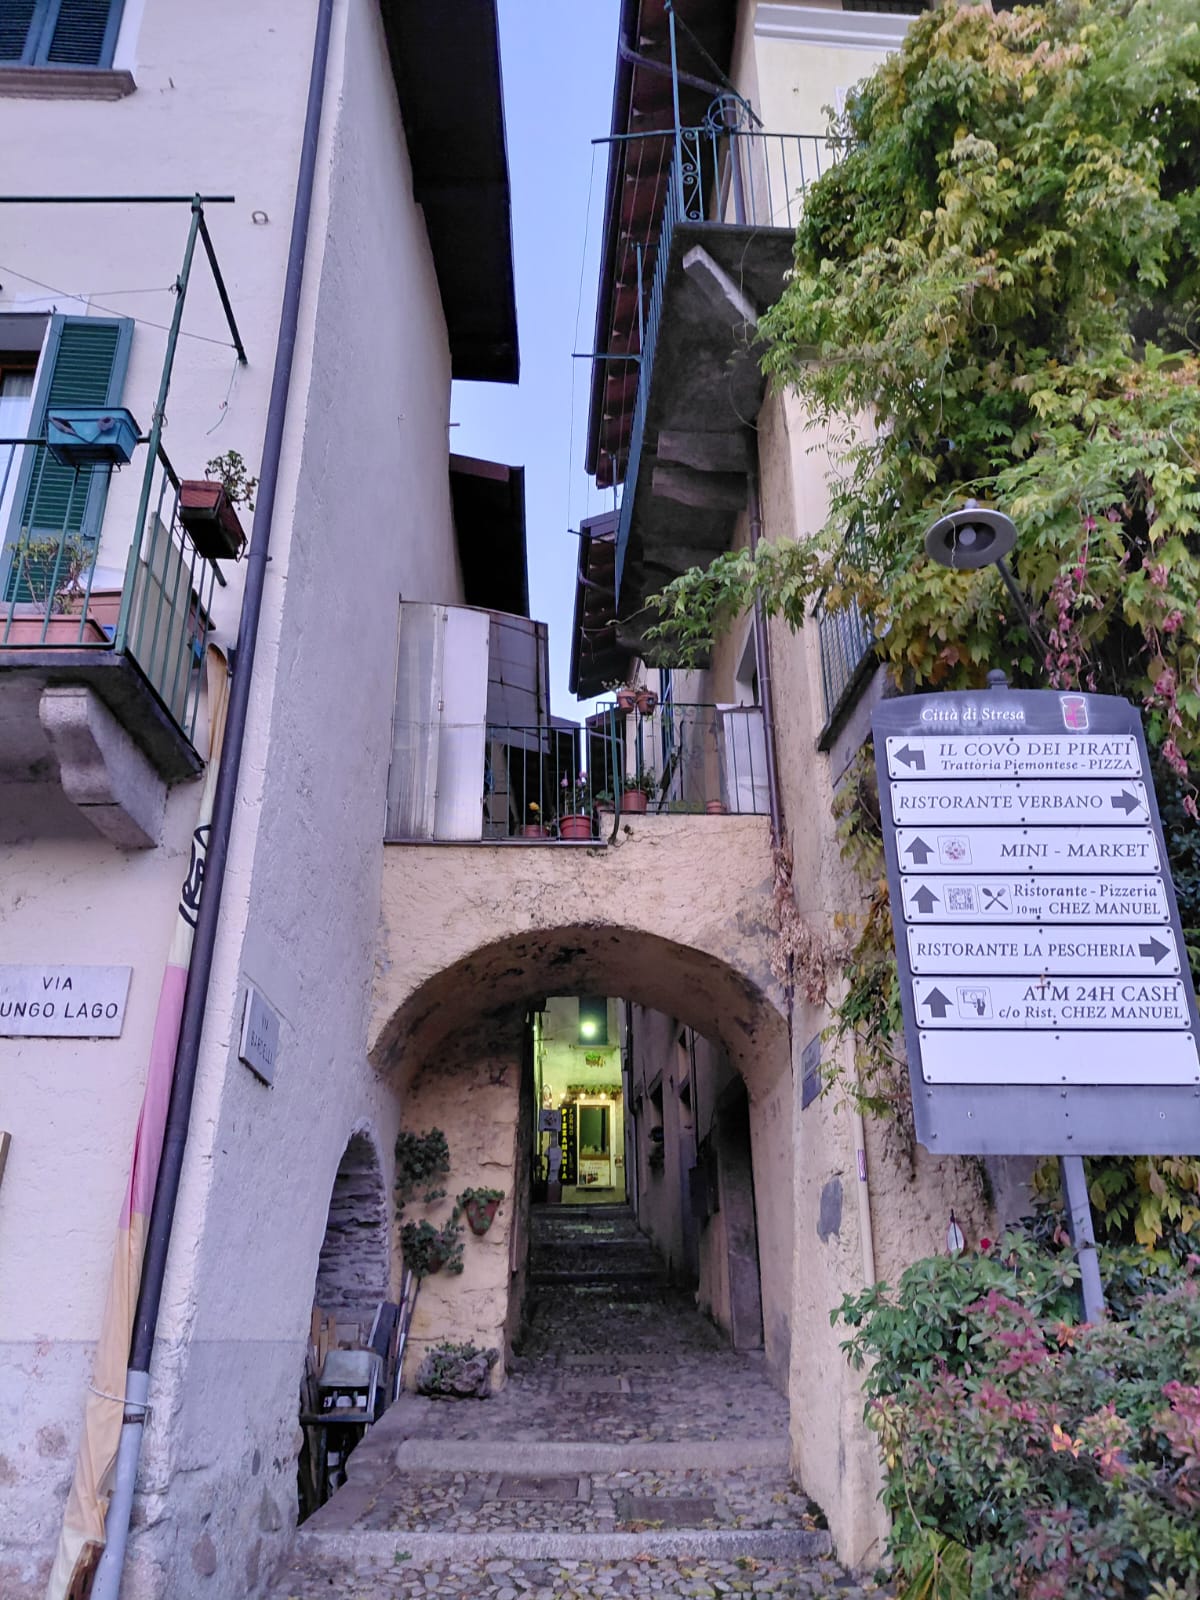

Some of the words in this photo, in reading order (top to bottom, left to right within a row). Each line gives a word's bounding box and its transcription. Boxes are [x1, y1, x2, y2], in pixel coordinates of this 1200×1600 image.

[922, 708, 957, 720] Città
[963, 707, 976, 720] di
[982, 708, 1024, 720] Stresa
[940, 744, 957, 756] IL
[965, 743, 1020, 755] COVO
[1028, 743, 1059, 755] DEI
[1069, 743, 1130, 755] PIRATI
[941, 759, 1000, 770] Trattoria
[1004, 759, 1077, 769] Piemontese
[1090, 759, 1132, 769] PIZZA
[900, 796, 1012, 808] RISTORANTE
[1018, 796, 1102, 808] VERBANO
[1001, 844, 1046, 856] MINI
[1068, 844, 1149, 856] MARKET
[1015, 884, 1087, 896] Ristorante
[1100, 884, 1157, 896] Pizzeria
[1016, 905, 1028, 914] 10
[1049, 903, 1090, 914] CHEZ
[1096, 903, 1160, 914] MANUEL
[918, 943, 1018, 956] RISTORANTE
[1024, 944, 1042, 956] LA
[1049, 944, 1135, 956] PESCHERIA
[43, 977, 72, 990] VIA
[1023, 986, 1068, 1001] ATM
[1077, 987, 1114, 1001] 24H
[1122, 986, 1177, 1001] CASH
[0, 1002, 54, 1017] UNGO
[64, 1003, 117, 1018] LAGO
[999, 1006, 1020, 1018] c/o
[1026, 1006, 1056, 1018] Rist.
[1062, 1007, 1106, 1018] CHEZ
[1112, 1007, 1182, 1018] MANUEL
